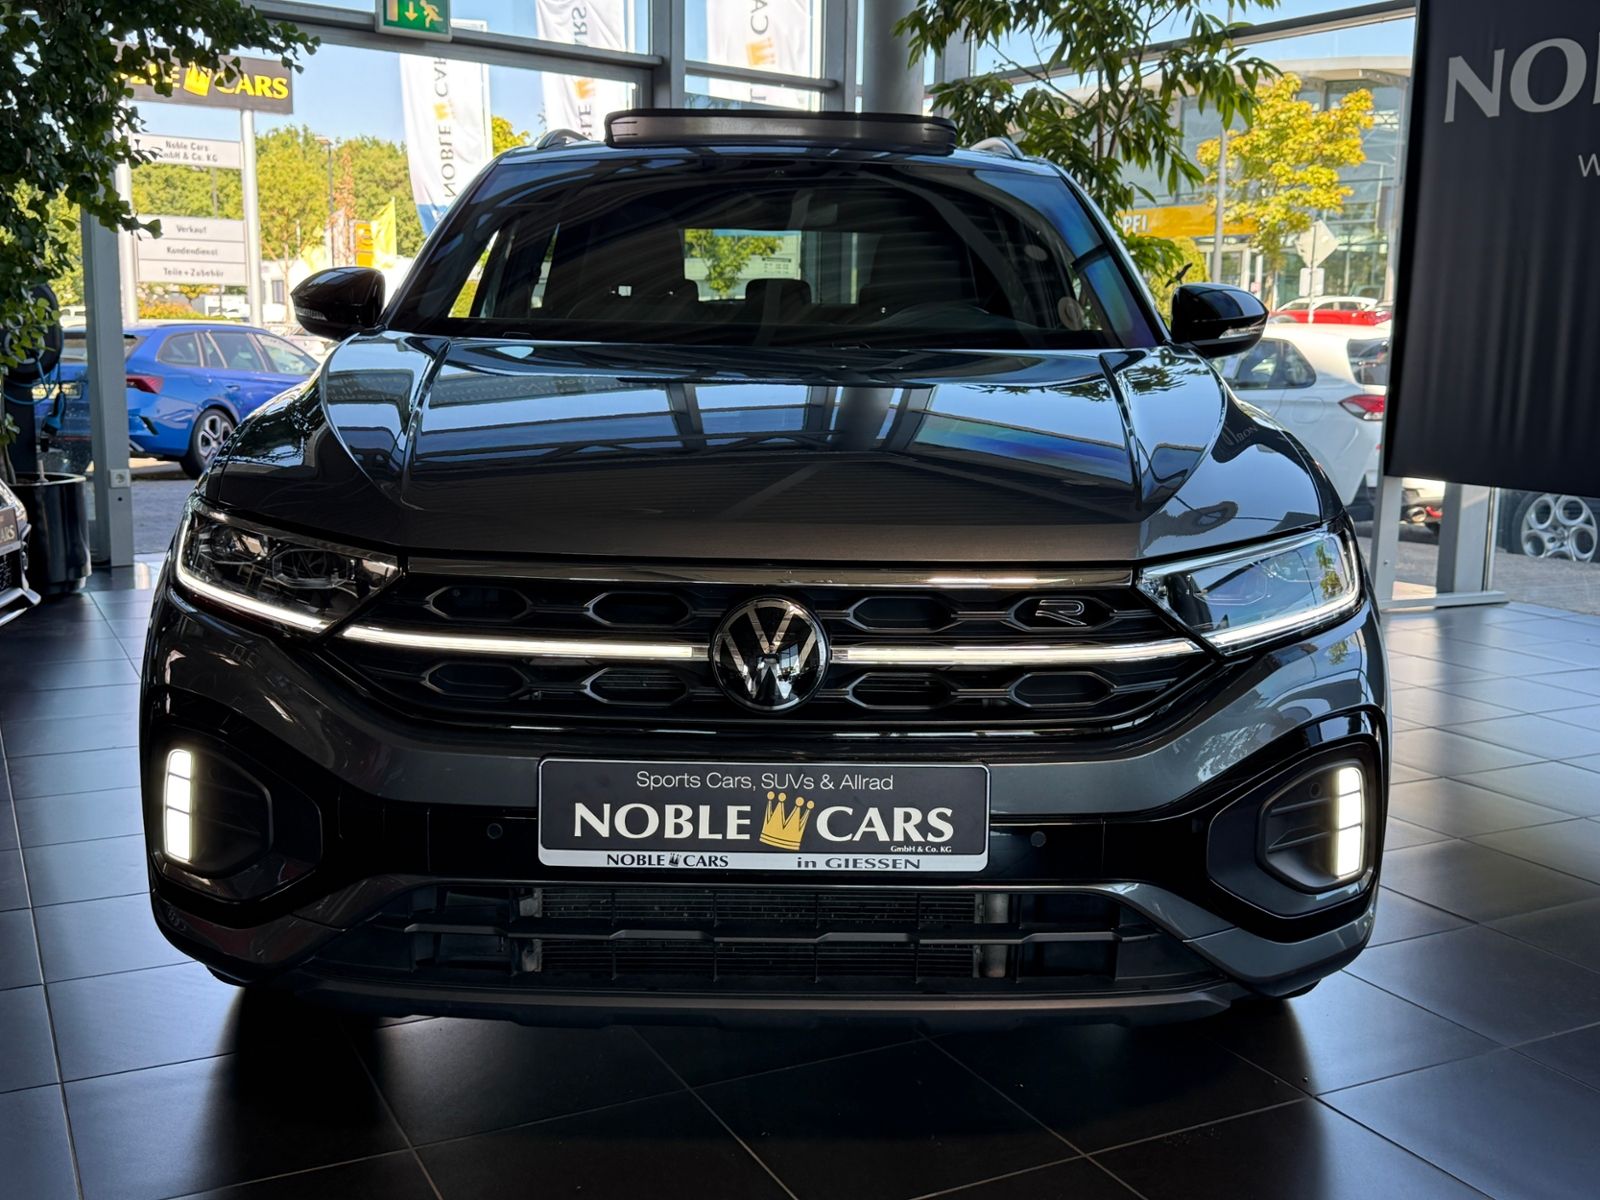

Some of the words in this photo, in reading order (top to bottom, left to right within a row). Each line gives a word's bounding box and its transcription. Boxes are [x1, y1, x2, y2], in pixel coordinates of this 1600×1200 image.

[1443, 32, 1600, 123] NO
[176, 224, 208, 234] Verkauf
[636, 770, 701, 791] Sports
[706, 771, 757, 792] Cars,
[761, 772, 815, 790] SUVs
[820, 773, 835, 790] &
[839, 773, 894, 791] Allrad
[574, 802, 752, 840] NOBLE
[816, 805, 955, 843] CARS
[890, 845, 915, 853] GmbH
[917, 845, 924, 853] &
[925, 845, 939, 853] Co.
[940, 845, 952, 854] KG
[606, 854, 665, 867] NOBLE
[683, 855, 729, 868] CARS
[797, 856, 817, 869] in
[825, 857, 921, 870] GIESSEN
